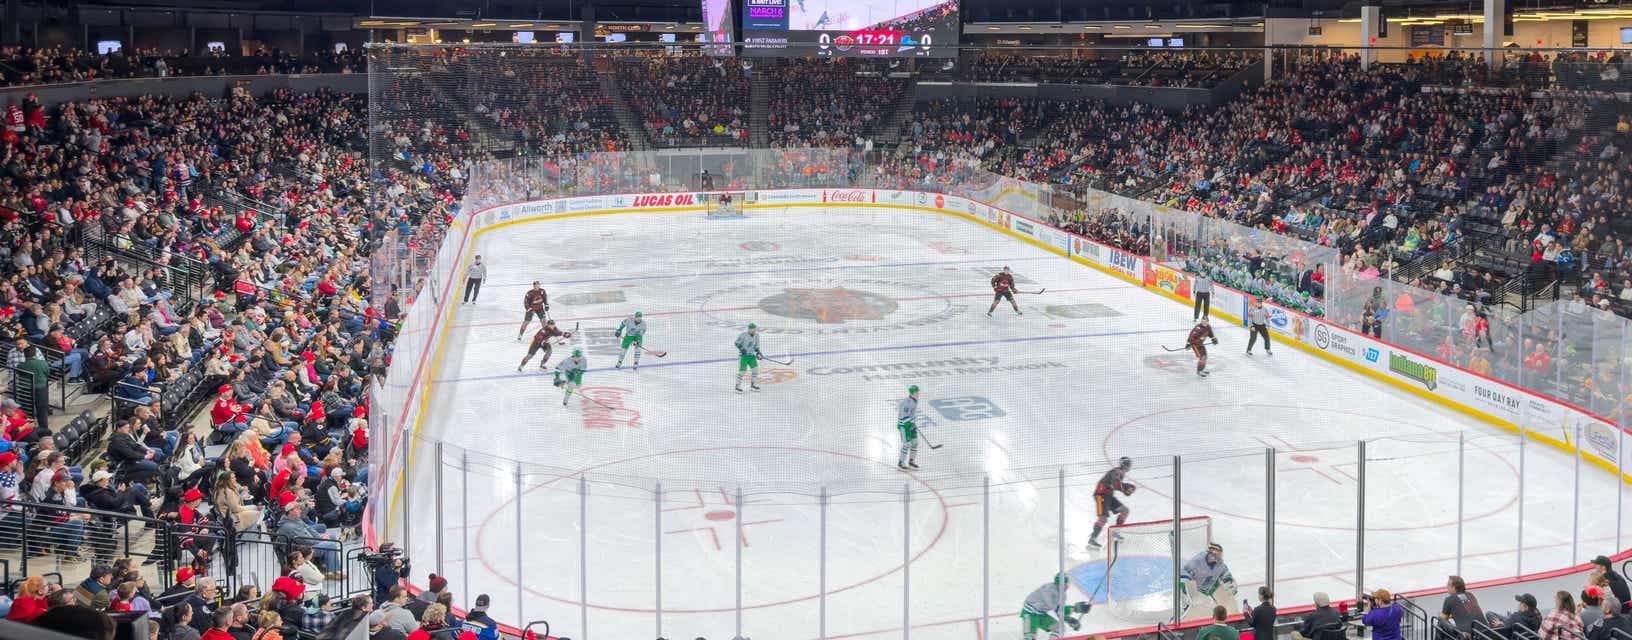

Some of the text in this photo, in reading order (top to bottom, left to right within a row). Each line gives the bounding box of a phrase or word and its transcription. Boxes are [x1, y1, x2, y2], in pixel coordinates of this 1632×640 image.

[750, 7, 777, 16] MARCH
[819, 33, 830, 50] 0
[920, 34, 931, 50] 0
[632, 194, 694, 207] LUCAS OIL
[831, 190, 865, 202] Coca-Cola
[521, 202, 553, 214] Allworth
[1110, 249, 1137, 271] IBEW
[807, 356, 1000, 376] Community
[1474, 385, 1491, 400] FOUR
[1492, 391, 1506, 405] DAY
[1506, 397, 1521, 409] RAY
